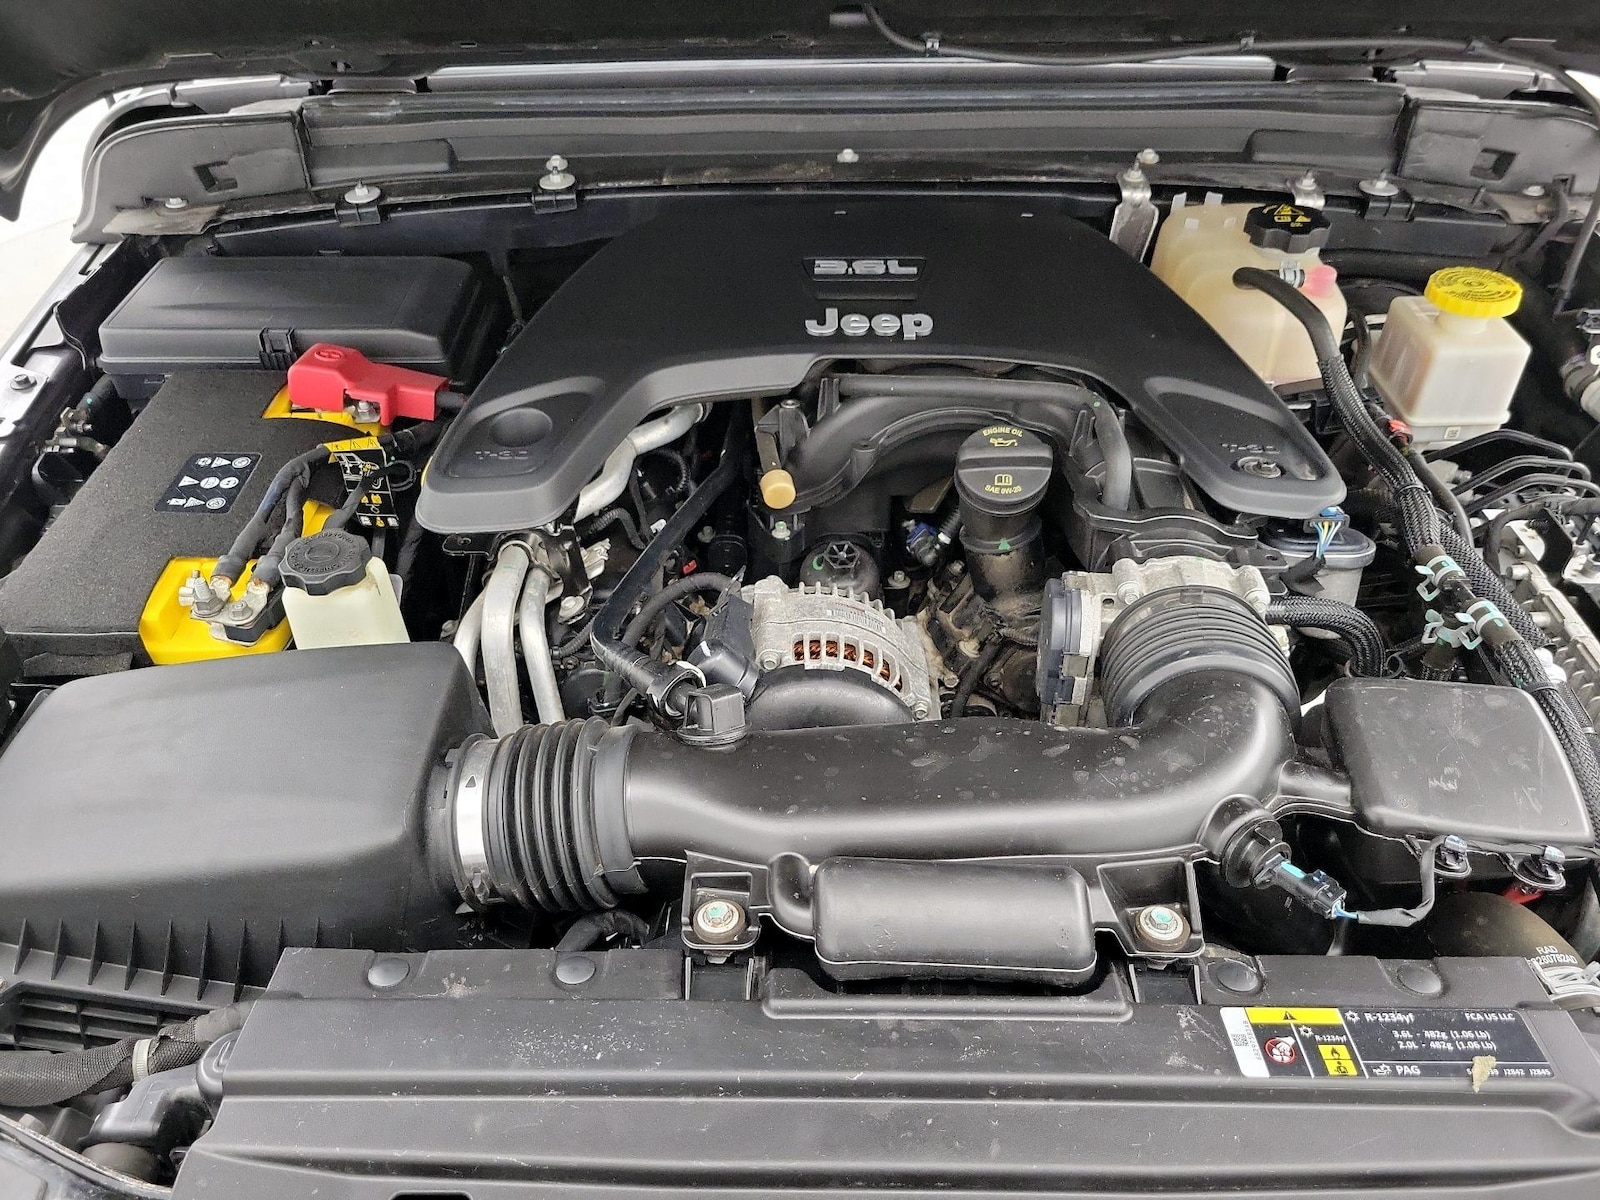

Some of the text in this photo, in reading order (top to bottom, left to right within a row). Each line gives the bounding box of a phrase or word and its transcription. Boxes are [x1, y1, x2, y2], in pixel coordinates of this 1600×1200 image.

[804, 307, 934, 341] Jeep
[982, 426, 1024, 438] ENGINE OIL
[984, 484, 1000, 494] SAE
[1535, 945, 1558, 954] RAD
[1364, 1012, 1415, 1025] R-1234yf
[1464, 1012, 1516, 1022] FCA US LLC
[1392, 1030, 1414, 1039] 3.6L
[1423, 1030, 1449, 1040] 482g
[1450, 1030, 1475, 1040] (1.06
[1475, 1030, 1491, 1041] Lb)
[1397, 1041, 1419, 1050] 2.0L
[1429, 1041, 1454, 1051] 482g
[1456, 1041, 1481, 1051] (1.06
[1481, 1041, 1497, 1052] Lb)
[1396, 1065, 1421, 1076] PAG
